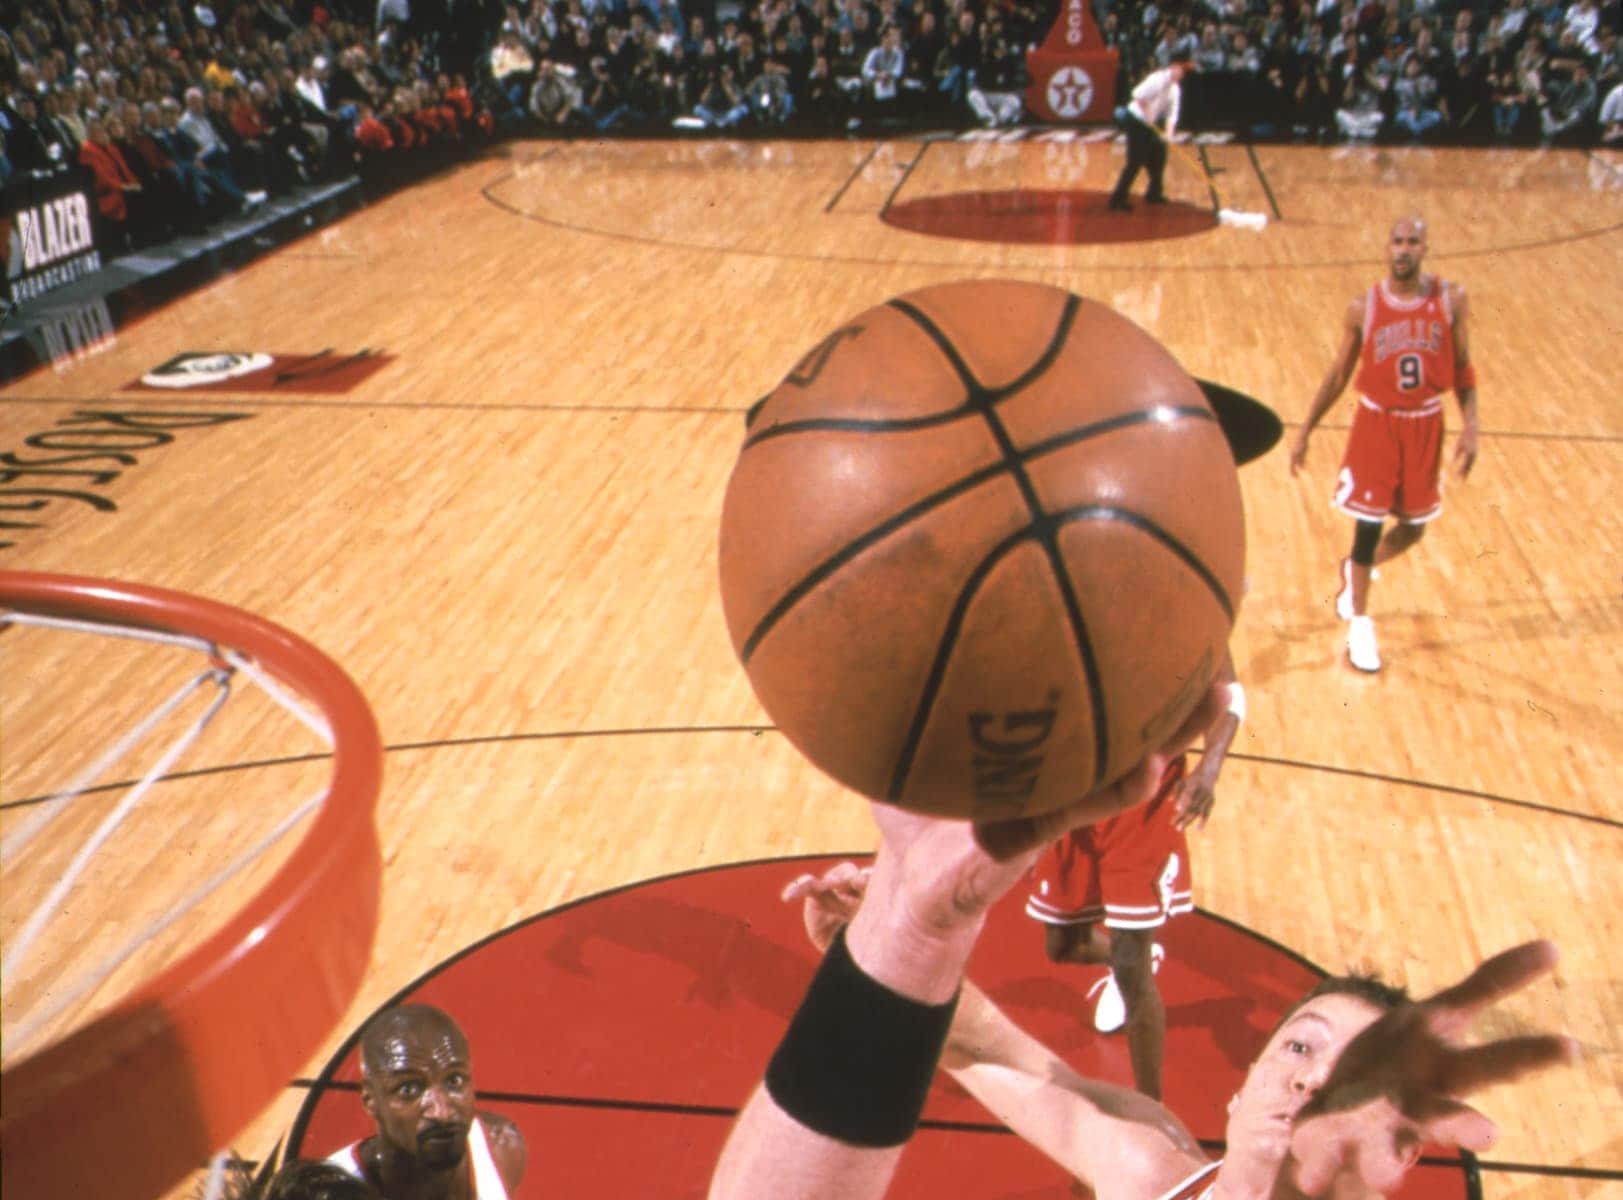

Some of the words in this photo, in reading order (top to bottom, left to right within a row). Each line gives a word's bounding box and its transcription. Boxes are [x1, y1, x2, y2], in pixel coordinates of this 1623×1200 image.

[17, 191, 93, 270] BLAZER
[1375, 319, 1443, 364] BULLS
[1398, 353, 1422, 391] 9
